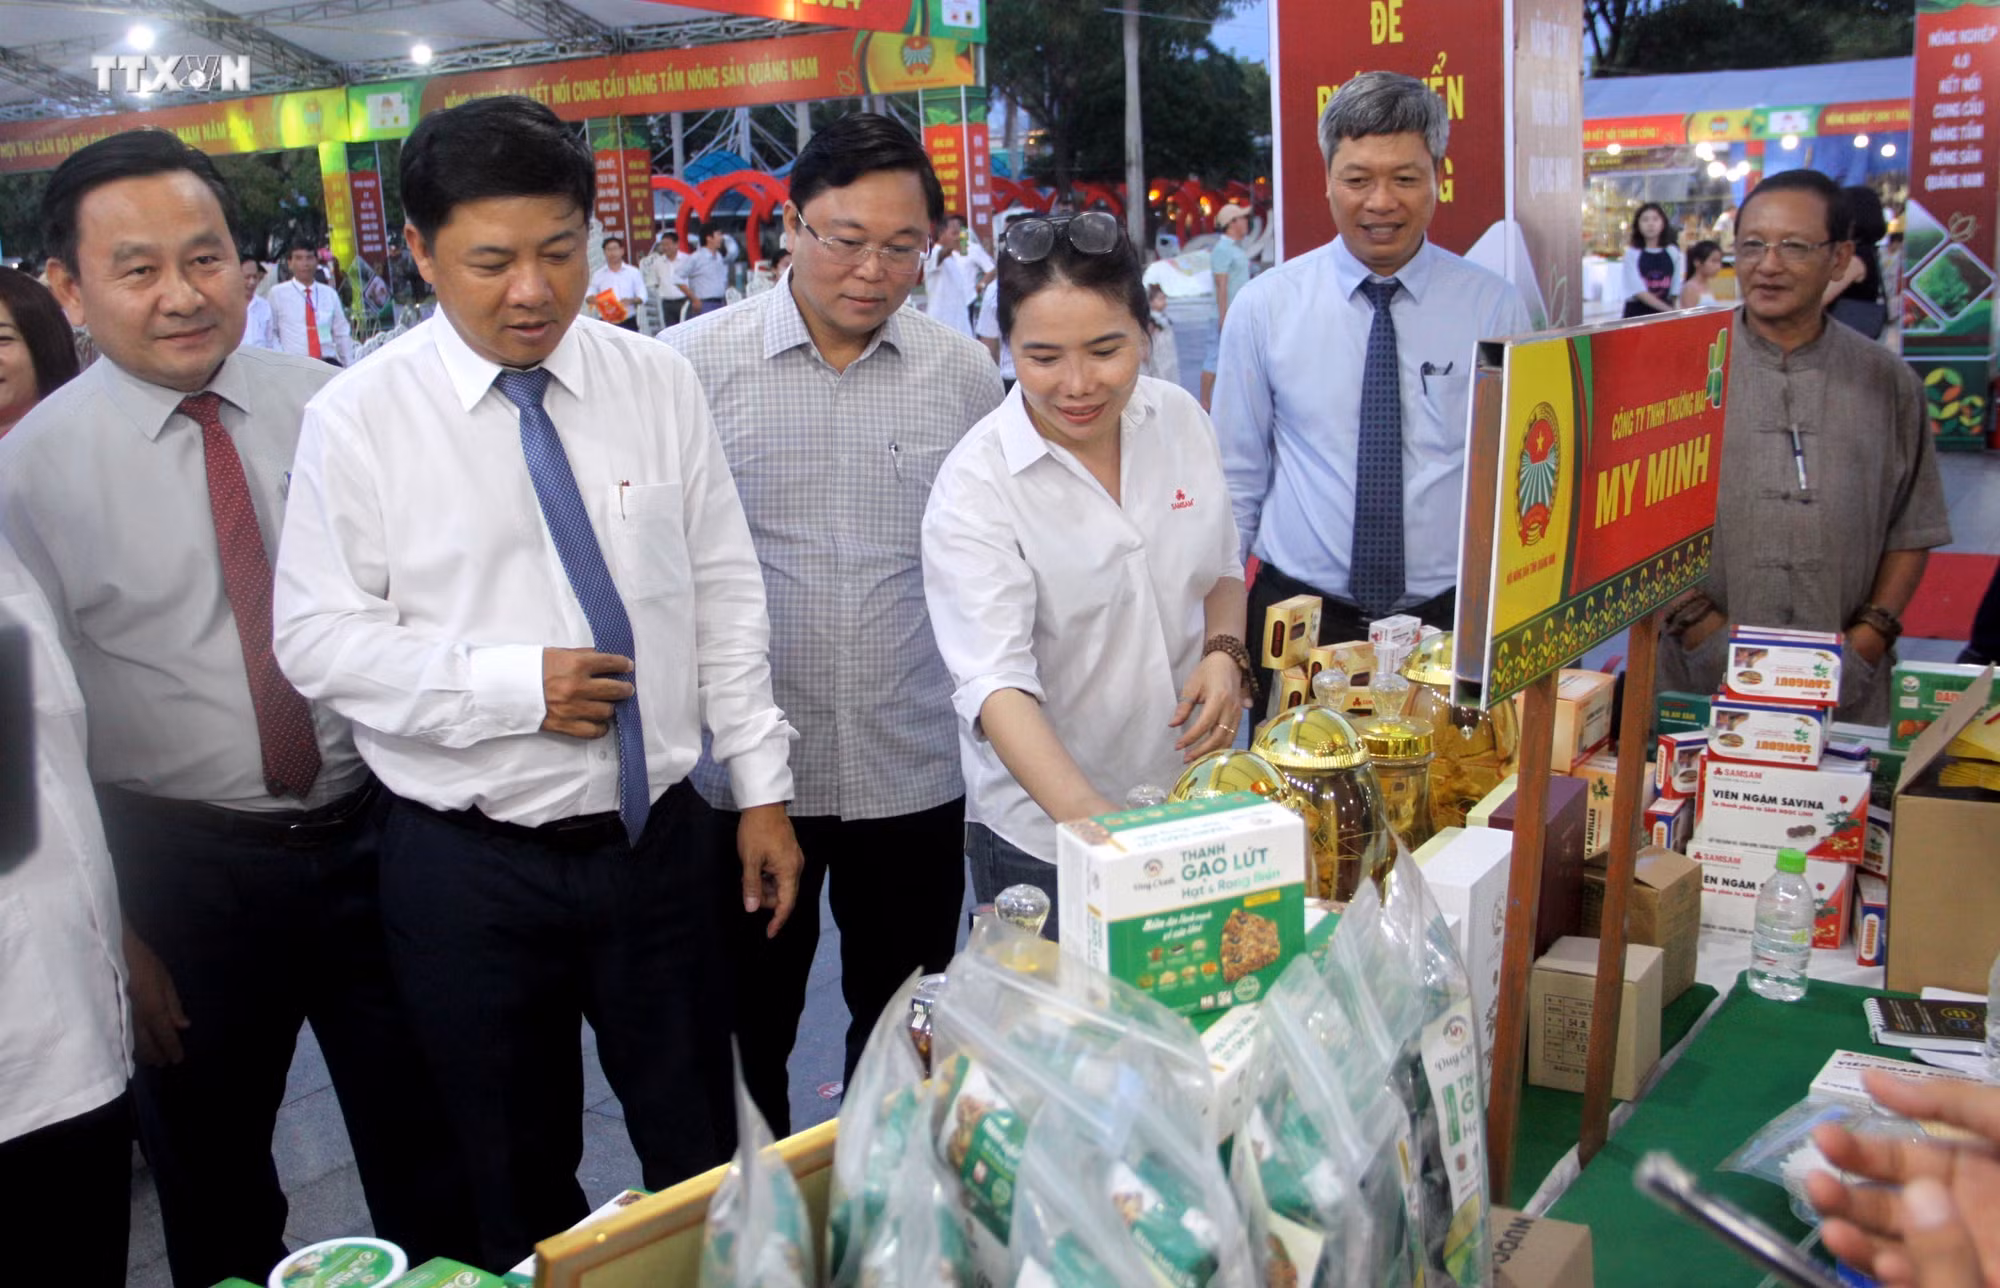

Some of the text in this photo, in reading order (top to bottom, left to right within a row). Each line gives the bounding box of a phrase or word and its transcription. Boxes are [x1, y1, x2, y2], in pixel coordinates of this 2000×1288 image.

[553, 75, 570, 104] NỐI
[573, 79, 600, 102] CUNG
[687, 64, 719, 90] NÔNG
[791, 56, 818, 80] NAM
[1612, 406, 1634, 440] CÔNG
[1635, 407, 1645, 430] TY
[1646, 400, 1666, 429] TNHH
[1595, 433, 1712, 529] MY MINH
[1724, 769, 1762, 779] SAMSAM
[1713, 789, 1824, 810] VIÊN NGẬM SAVINA
[1180, 843, 1226, 862] THANH
[1703, 853, 1741, 864] SAMSAM
[1181, 857, 1228, 882] GẠO
[1704, 875, 1756, 890] ÊN NGẬM
